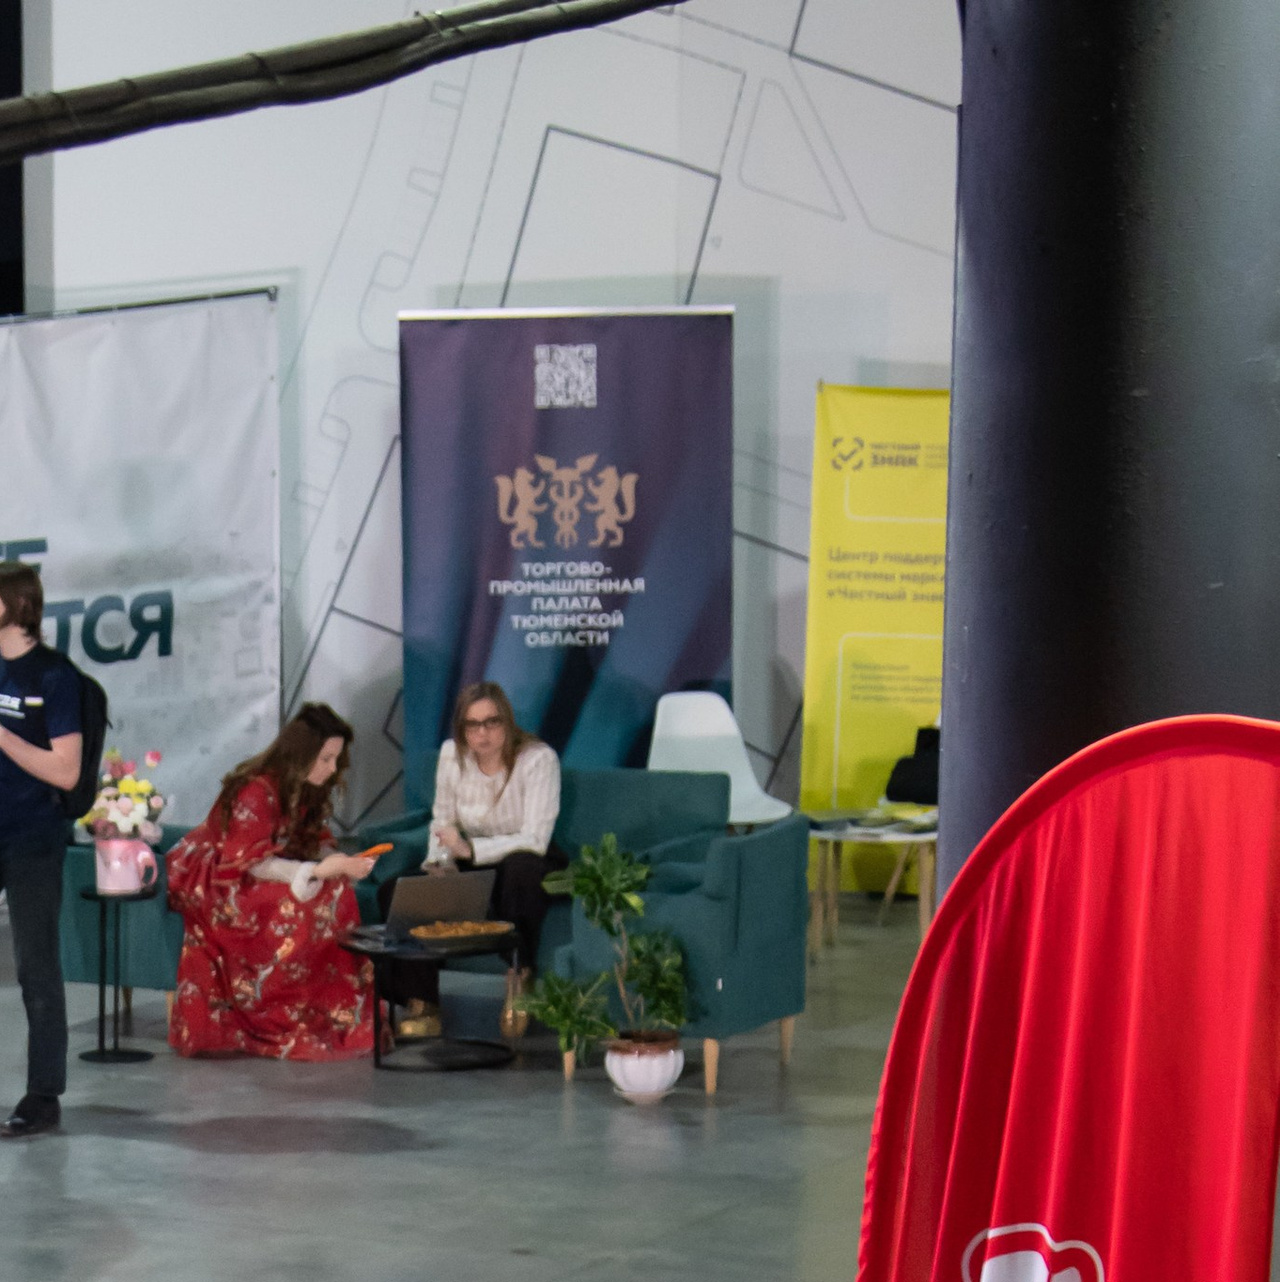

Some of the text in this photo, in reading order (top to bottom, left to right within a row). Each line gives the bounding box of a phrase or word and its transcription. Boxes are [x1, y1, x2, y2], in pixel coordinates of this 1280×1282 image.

[521, 561, 613, 578] ТОРГОВО-
[489, 577, 645, 596] ПРОМЫШЛЕННАЯ
[531, 596, 603, 612] ПАЛАТА
[510, 610, 625, 630] ТЮМЕНСКОЙ
[524, 631, 610, 648] ОБЛАСТИ
